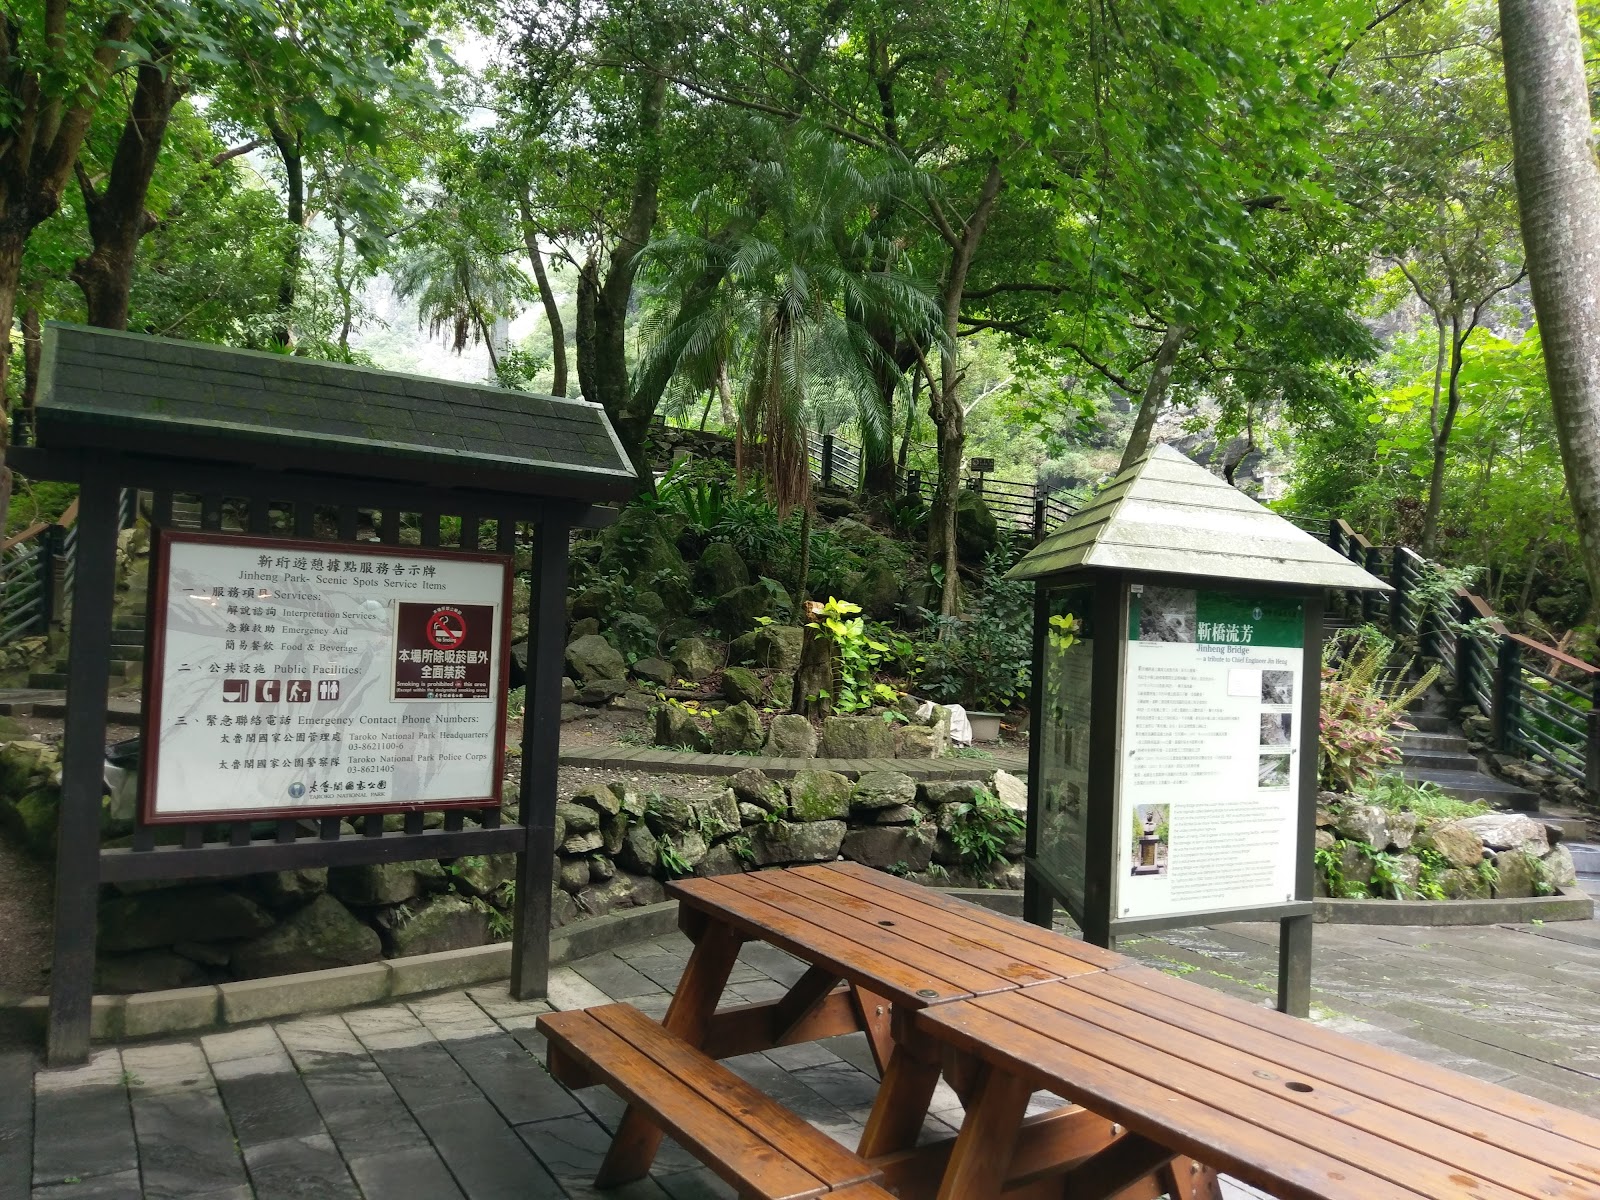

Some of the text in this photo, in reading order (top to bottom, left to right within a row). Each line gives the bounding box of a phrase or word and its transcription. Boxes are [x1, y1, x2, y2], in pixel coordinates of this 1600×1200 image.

[257, 554, 437, 578] 靳珩遊憩據點服務告示牌
[238, 570, 278, 583] Jinheng
[316, 574, 348, 585] Scenic
[353, 577, 379, 588] Spots
[384, 578, 418, 589] Service
[423, 581, 447, 590] Items
[274, 590, 321, 601] Services:
[226, 605, 277, 617] 解說諮詢
[283, 609, 377, 621] Interpretation Services
[225, 622, 276, 633] 急難救助
[282, 626, 348, 637] Emergency Aid
[1197, 621, 1254, 643] 靳橋流芳
[225, 640, 274, 651] 簡易餐飲
[281, 643, 303, 651] Food
[319, 644, 358, 654] Beverage
[1196, 643, 1250, 655] Jinheng Bridge
[398, 649, 489, 664] 本場所除吸菸區外
[1245, 657, 1267, 665] Engineer
[1275, 658, 1288, 666] Heng
[274, 665, 362, 675] Public Facilities:
[421, 665, 467, 679] 全面禁菸
[298, 714, 479, 727] Emergency Contact Phone Numbers:
[220, 731, 342, 744] 太魯閣國家公園管理處
[349, 731, 488, 741] Taroko National Park Headquarters
[348, 742, 404, 751] 03-8621100-6
[218, 756, 340, 770] 太魯閣國家公園警察隊
[348, 753, 487, 764] Taroko National Park Police Corps
[347, 764, 395, 774] 03-8621405
